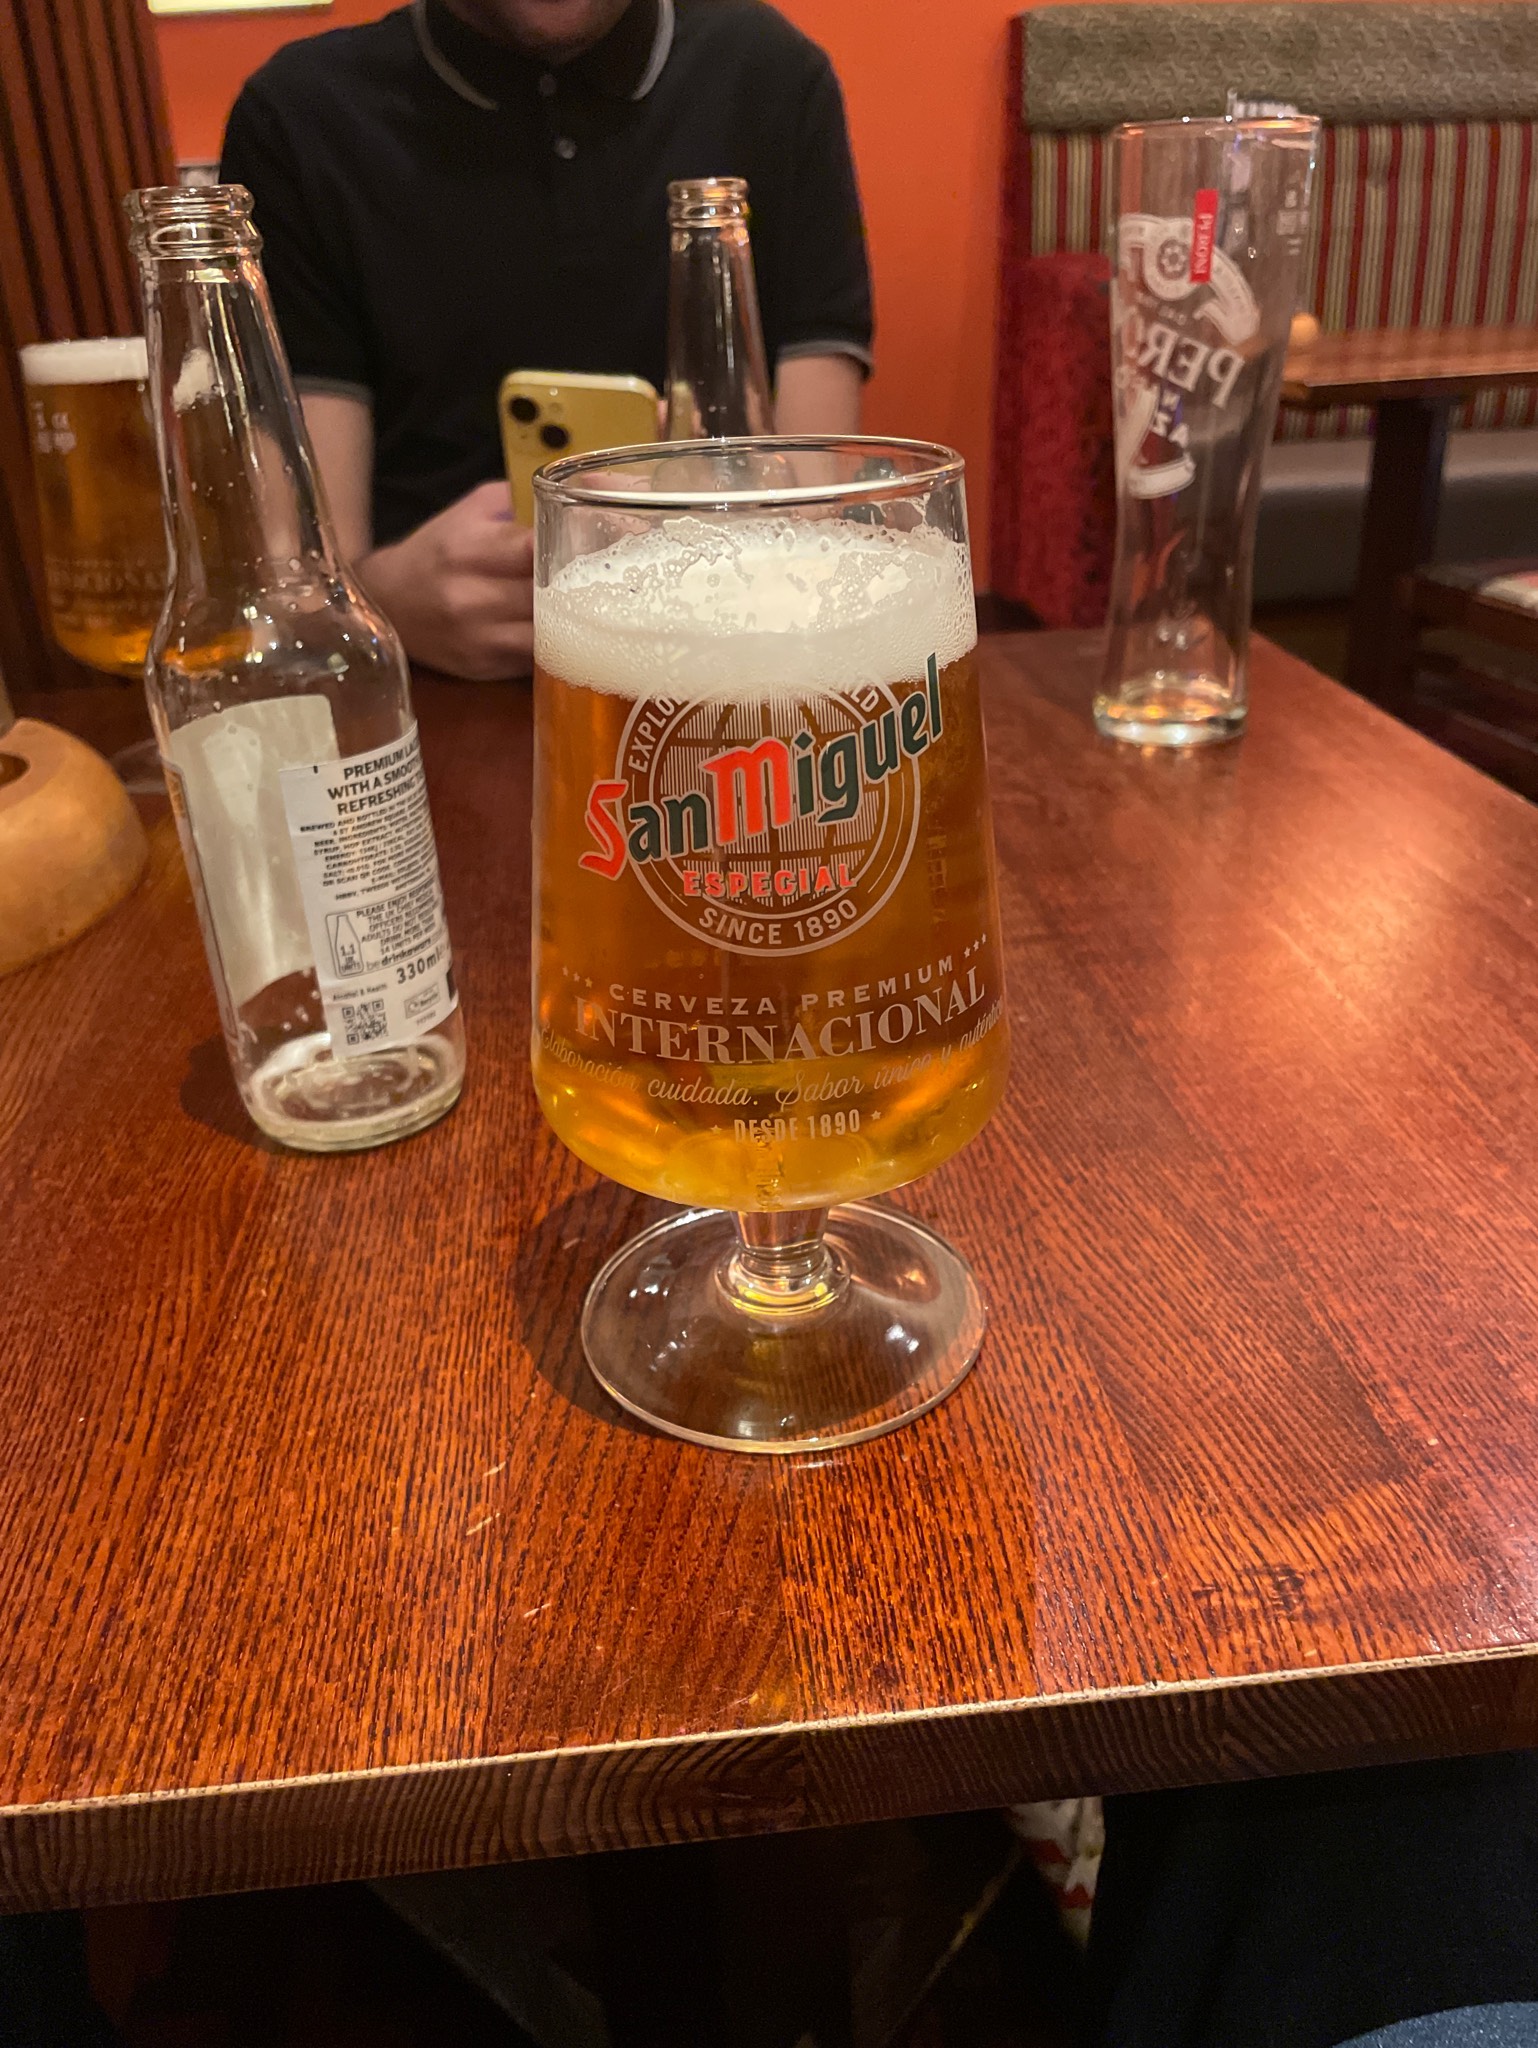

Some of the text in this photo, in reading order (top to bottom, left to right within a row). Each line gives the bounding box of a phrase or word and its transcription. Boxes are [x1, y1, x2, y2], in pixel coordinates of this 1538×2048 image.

[342, 748, 404, 780] PREMIUM
[701, 651, 944, 848] Miguel
[327, 778, 370, 800] WITH
[371, 774, 382, 790] A
[683, 863, 857, 899] ESPECIAL
[698, 898, 859, 945] SINCE 1890
[395, 945, 440, 985] 330ml
[608, 954, 955, 1016] CERVEZA PREMIUM
[574, 965, 987, 1066] INTERNACIONAL
[775, 1070, 865, 1112] Sabor
[733, 1108, 862, 1146] DESDE 1890
